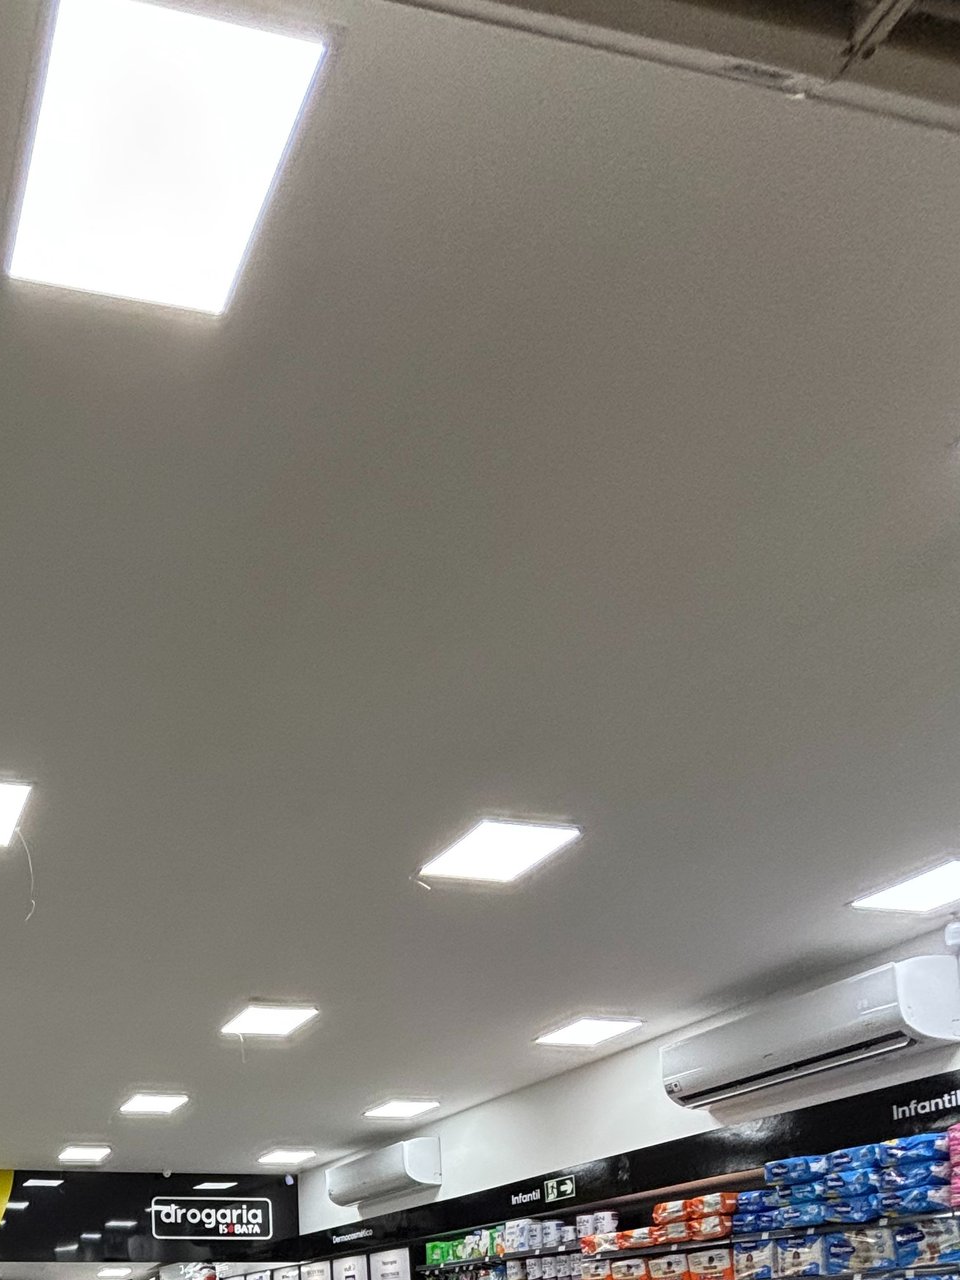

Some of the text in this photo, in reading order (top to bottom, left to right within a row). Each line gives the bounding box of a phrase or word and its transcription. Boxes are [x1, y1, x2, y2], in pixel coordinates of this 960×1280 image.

[892, 1089, 960, 1121] Infantil
[511, 1189, 540, 1205] Infantil
[160, 1204, 263, 1229] drogaria
